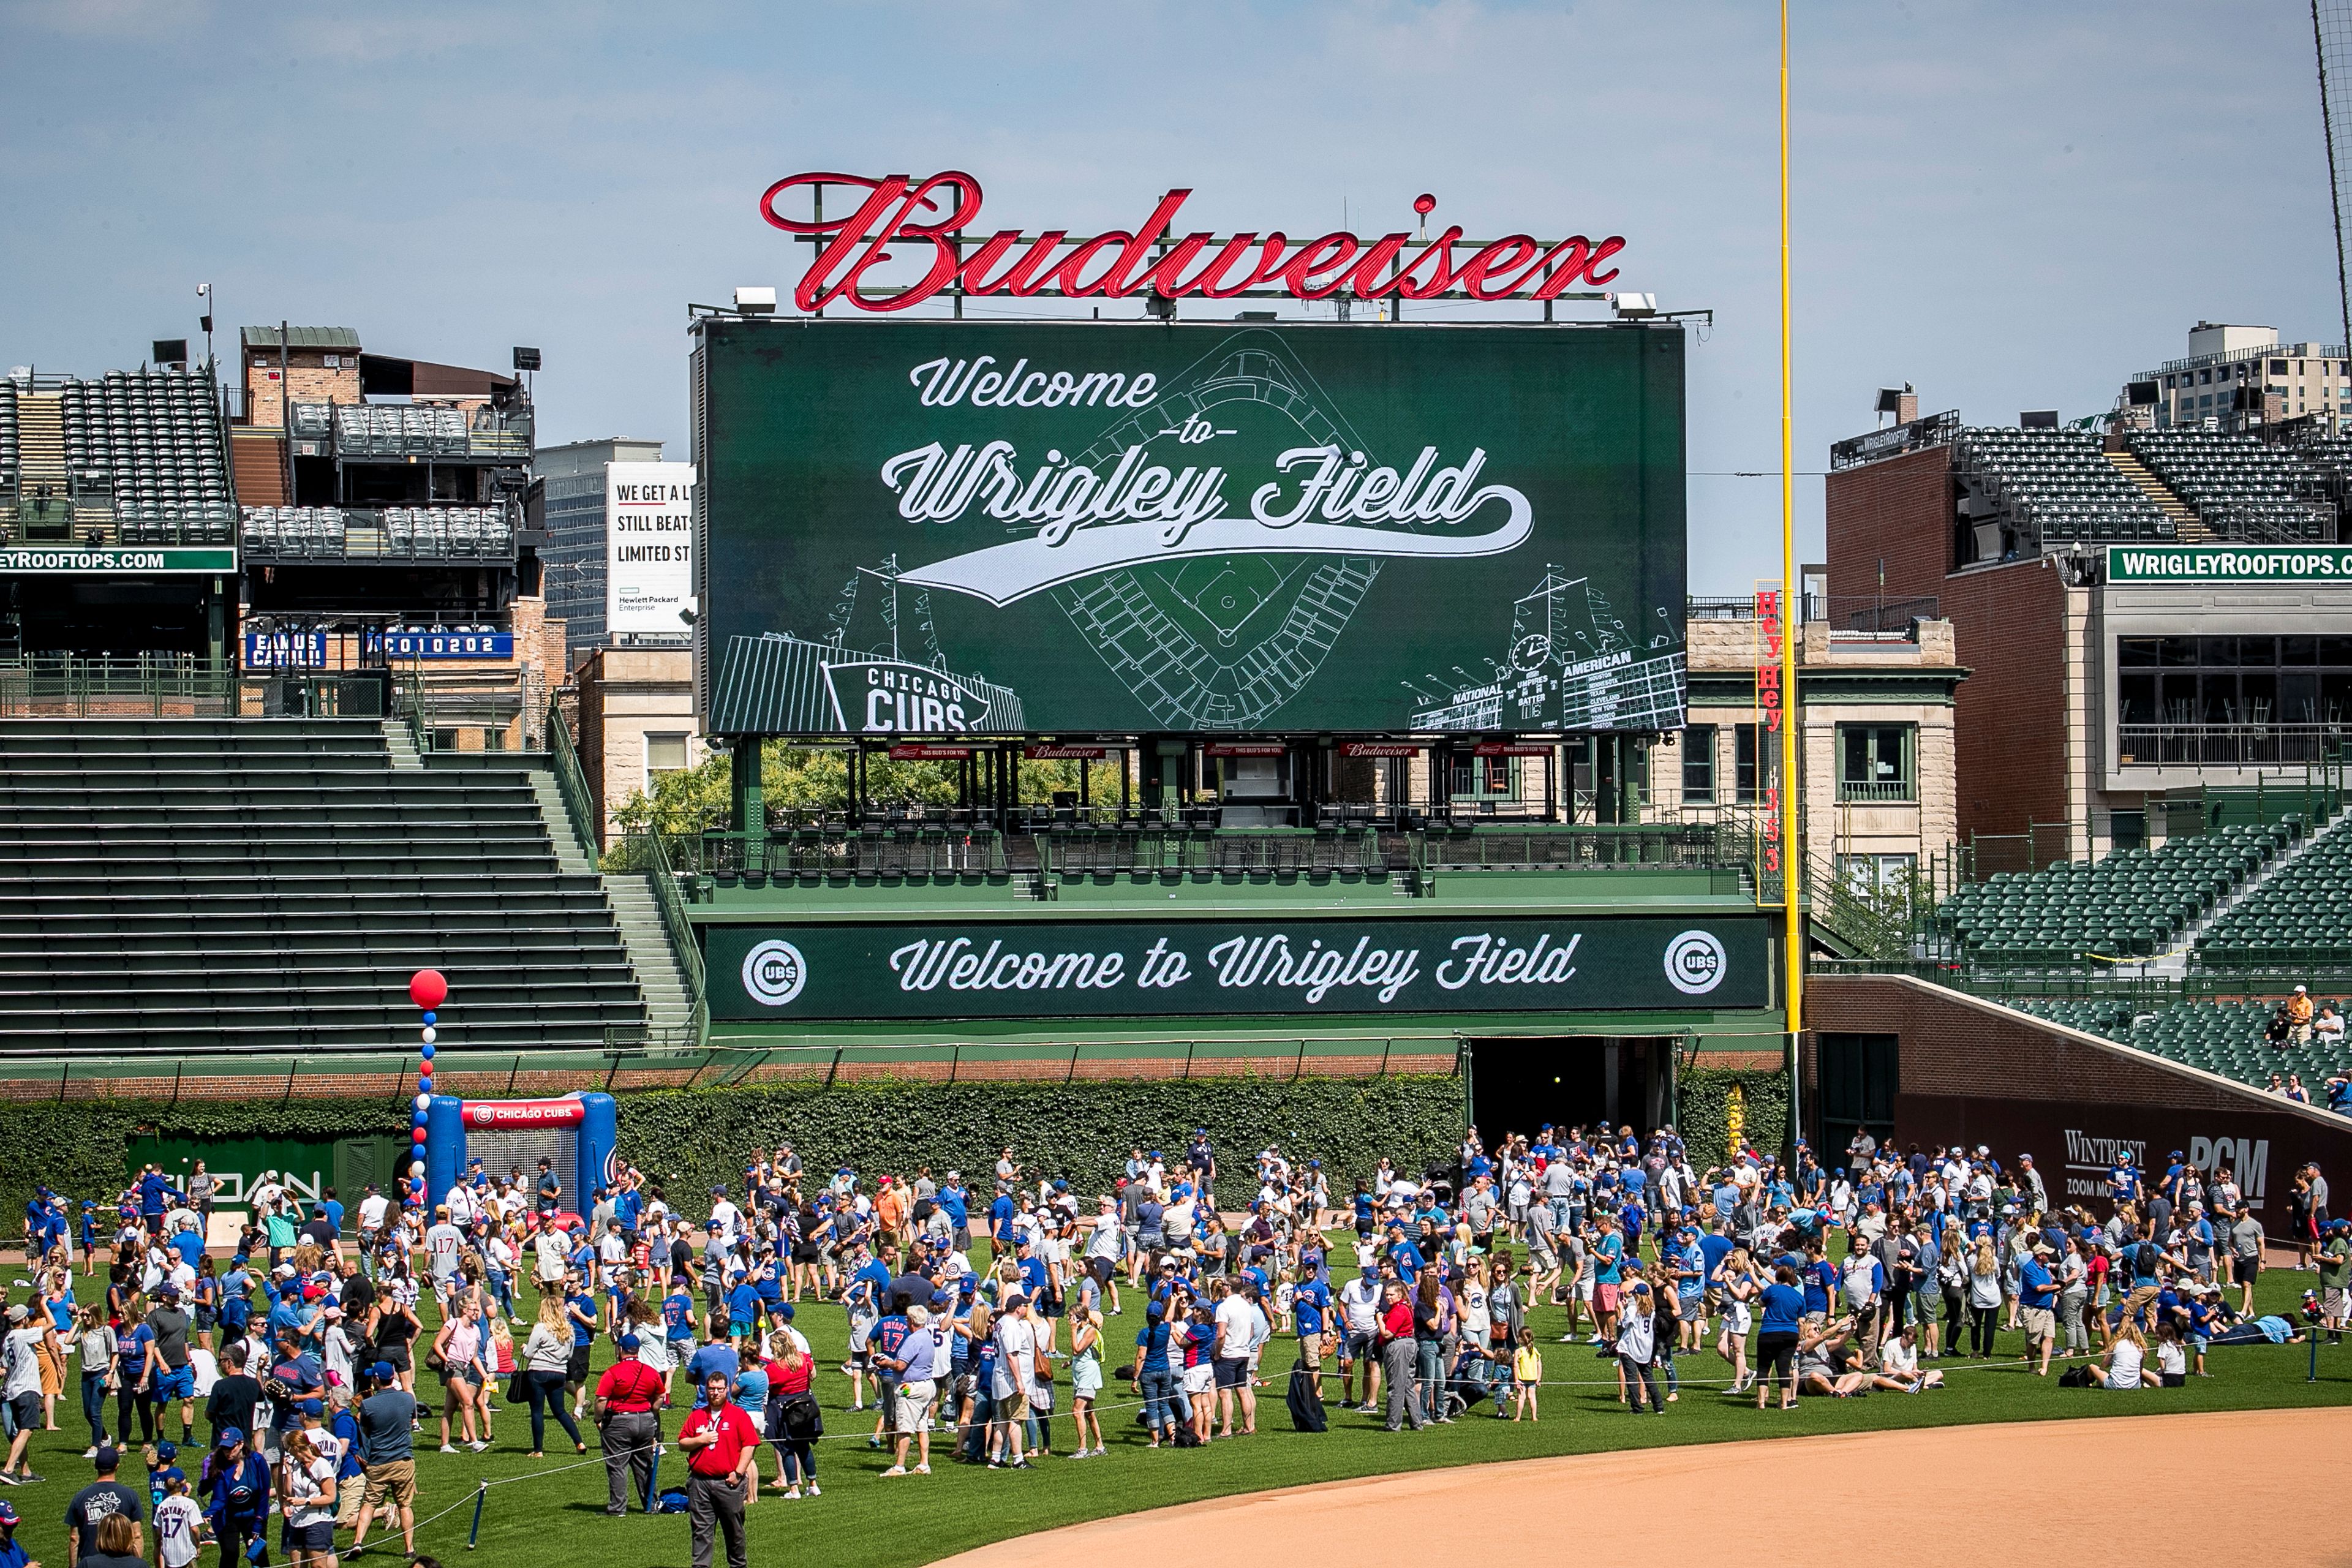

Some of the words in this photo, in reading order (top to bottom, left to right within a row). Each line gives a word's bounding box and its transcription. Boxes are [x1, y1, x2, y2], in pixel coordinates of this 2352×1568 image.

[760, 170, 1626, 312] Budweiser
[910, 356, 1158, 407] Welcome
[617, 485, 638, 500] WE
[643, 485, 666, 500] GET
[670, 485, 678, 500] A
[881, 440, 1227, 547] Wrigley
[1251, 443, 1487, 529] Field
[618, 516, 652, 531] STILL
[618, 546, 670, 562] LIMITED
[1757, 592, 1783, 658] Hey
[1563, 650, 1632, 678] AMERICAN
[868, 668, 962, 702] CHICAGO
[1518, 675, 1548, 689] UMPIRES
[1452, 684, 1504, 705] NATIONAL
[1518, 693, 1546, 707] BATTER
[1590, 694, 1620, 705] CLEVELAND
[1758, 665, 1783, 732] Hey
[867, 688, 967, 731] CUBS
[1591, 712, 1616, 722] TORONTO
[1033, 745, 1098, 758] Budweiser
[1347, 743, 1411, 756] Budweiser
[1765, 788, 1779, 872] 353
[889, 937, 1126, 992] Welcome
[1137, 937, 1192, 988] to
[1208, 934, 1420, 1004] Wrigley
[1436, 933, 1581, 990] Field
[496, 1109, 541, 1119] CHICAGO
[2067, 1178, 2094, 1196] ZOOM
[439, 1238, 454, 1254] 17
[883, 1322, 908, 1332] BRYANT
[1643, 1320, 1651, 1333] 9
[883, 1332, 904, 1352] 17
[274, 1365, 300, 1380] CUBS
[160, 1507, 186, 1518] BRYANT
[163, 1518, 184, 1539] 17
